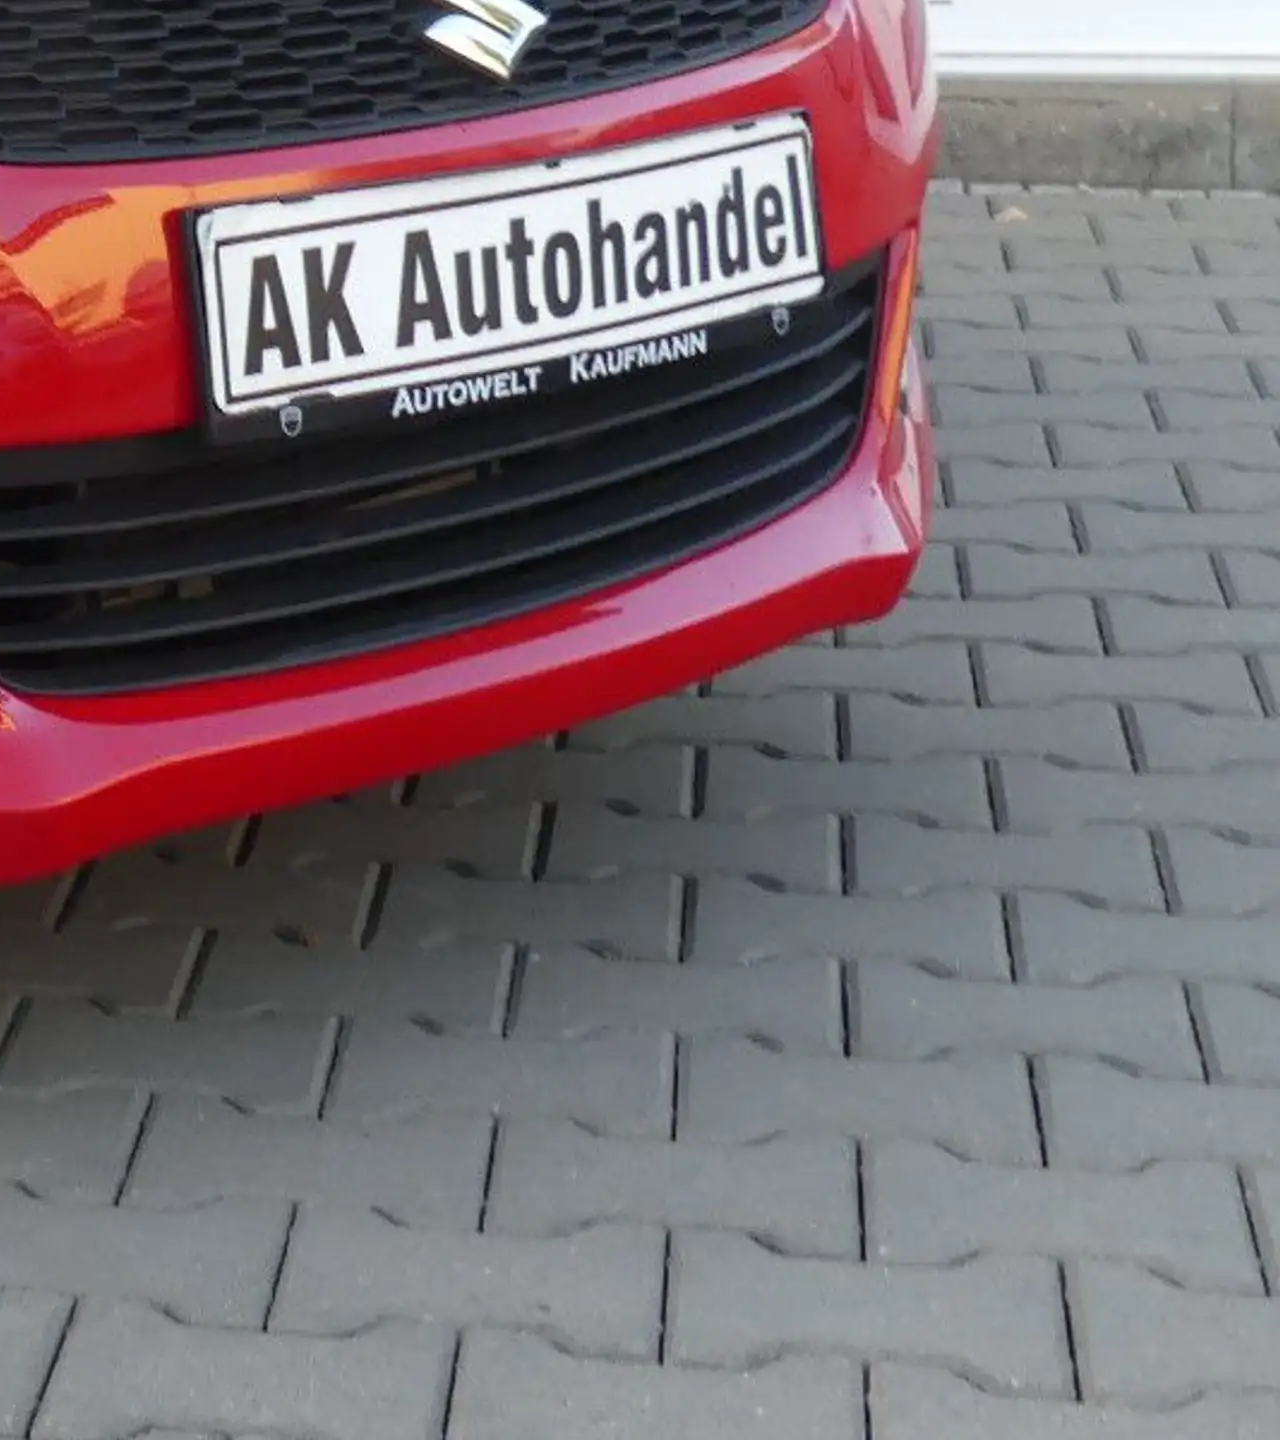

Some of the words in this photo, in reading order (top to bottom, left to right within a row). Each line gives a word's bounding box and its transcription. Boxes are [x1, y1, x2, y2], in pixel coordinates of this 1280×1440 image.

[244, 241, 365, 376] AK
[396, 154, 808, 348] Autohandel
[392, 367, 543, 418] AUTOWELT
[570, 330, 708, 384] KAUFMANN
